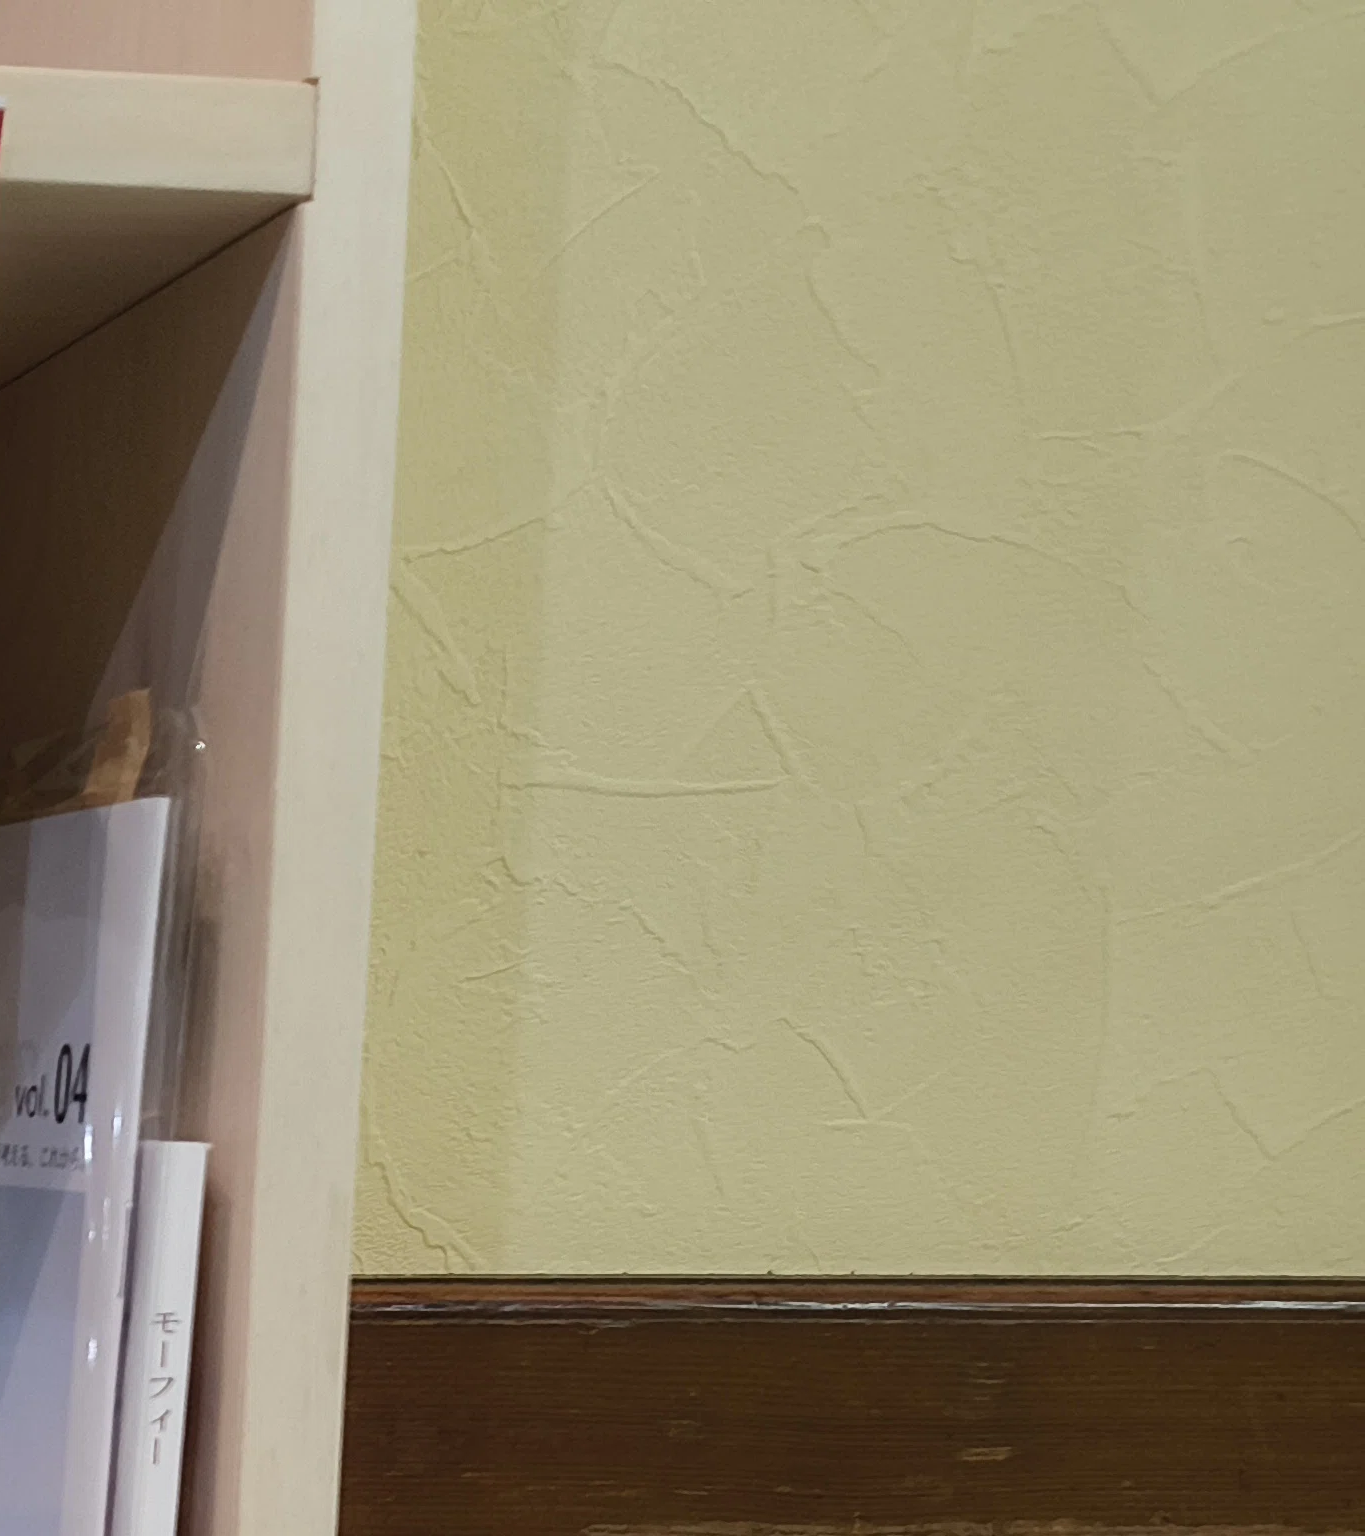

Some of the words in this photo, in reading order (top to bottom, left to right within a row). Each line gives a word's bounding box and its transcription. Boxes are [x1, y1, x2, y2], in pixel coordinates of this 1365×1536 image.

[15, 1076, 50, 1119] vol.
[54, 1043, 90, 1124] 04
[148, 1310, 183, 1466] モーフィー
